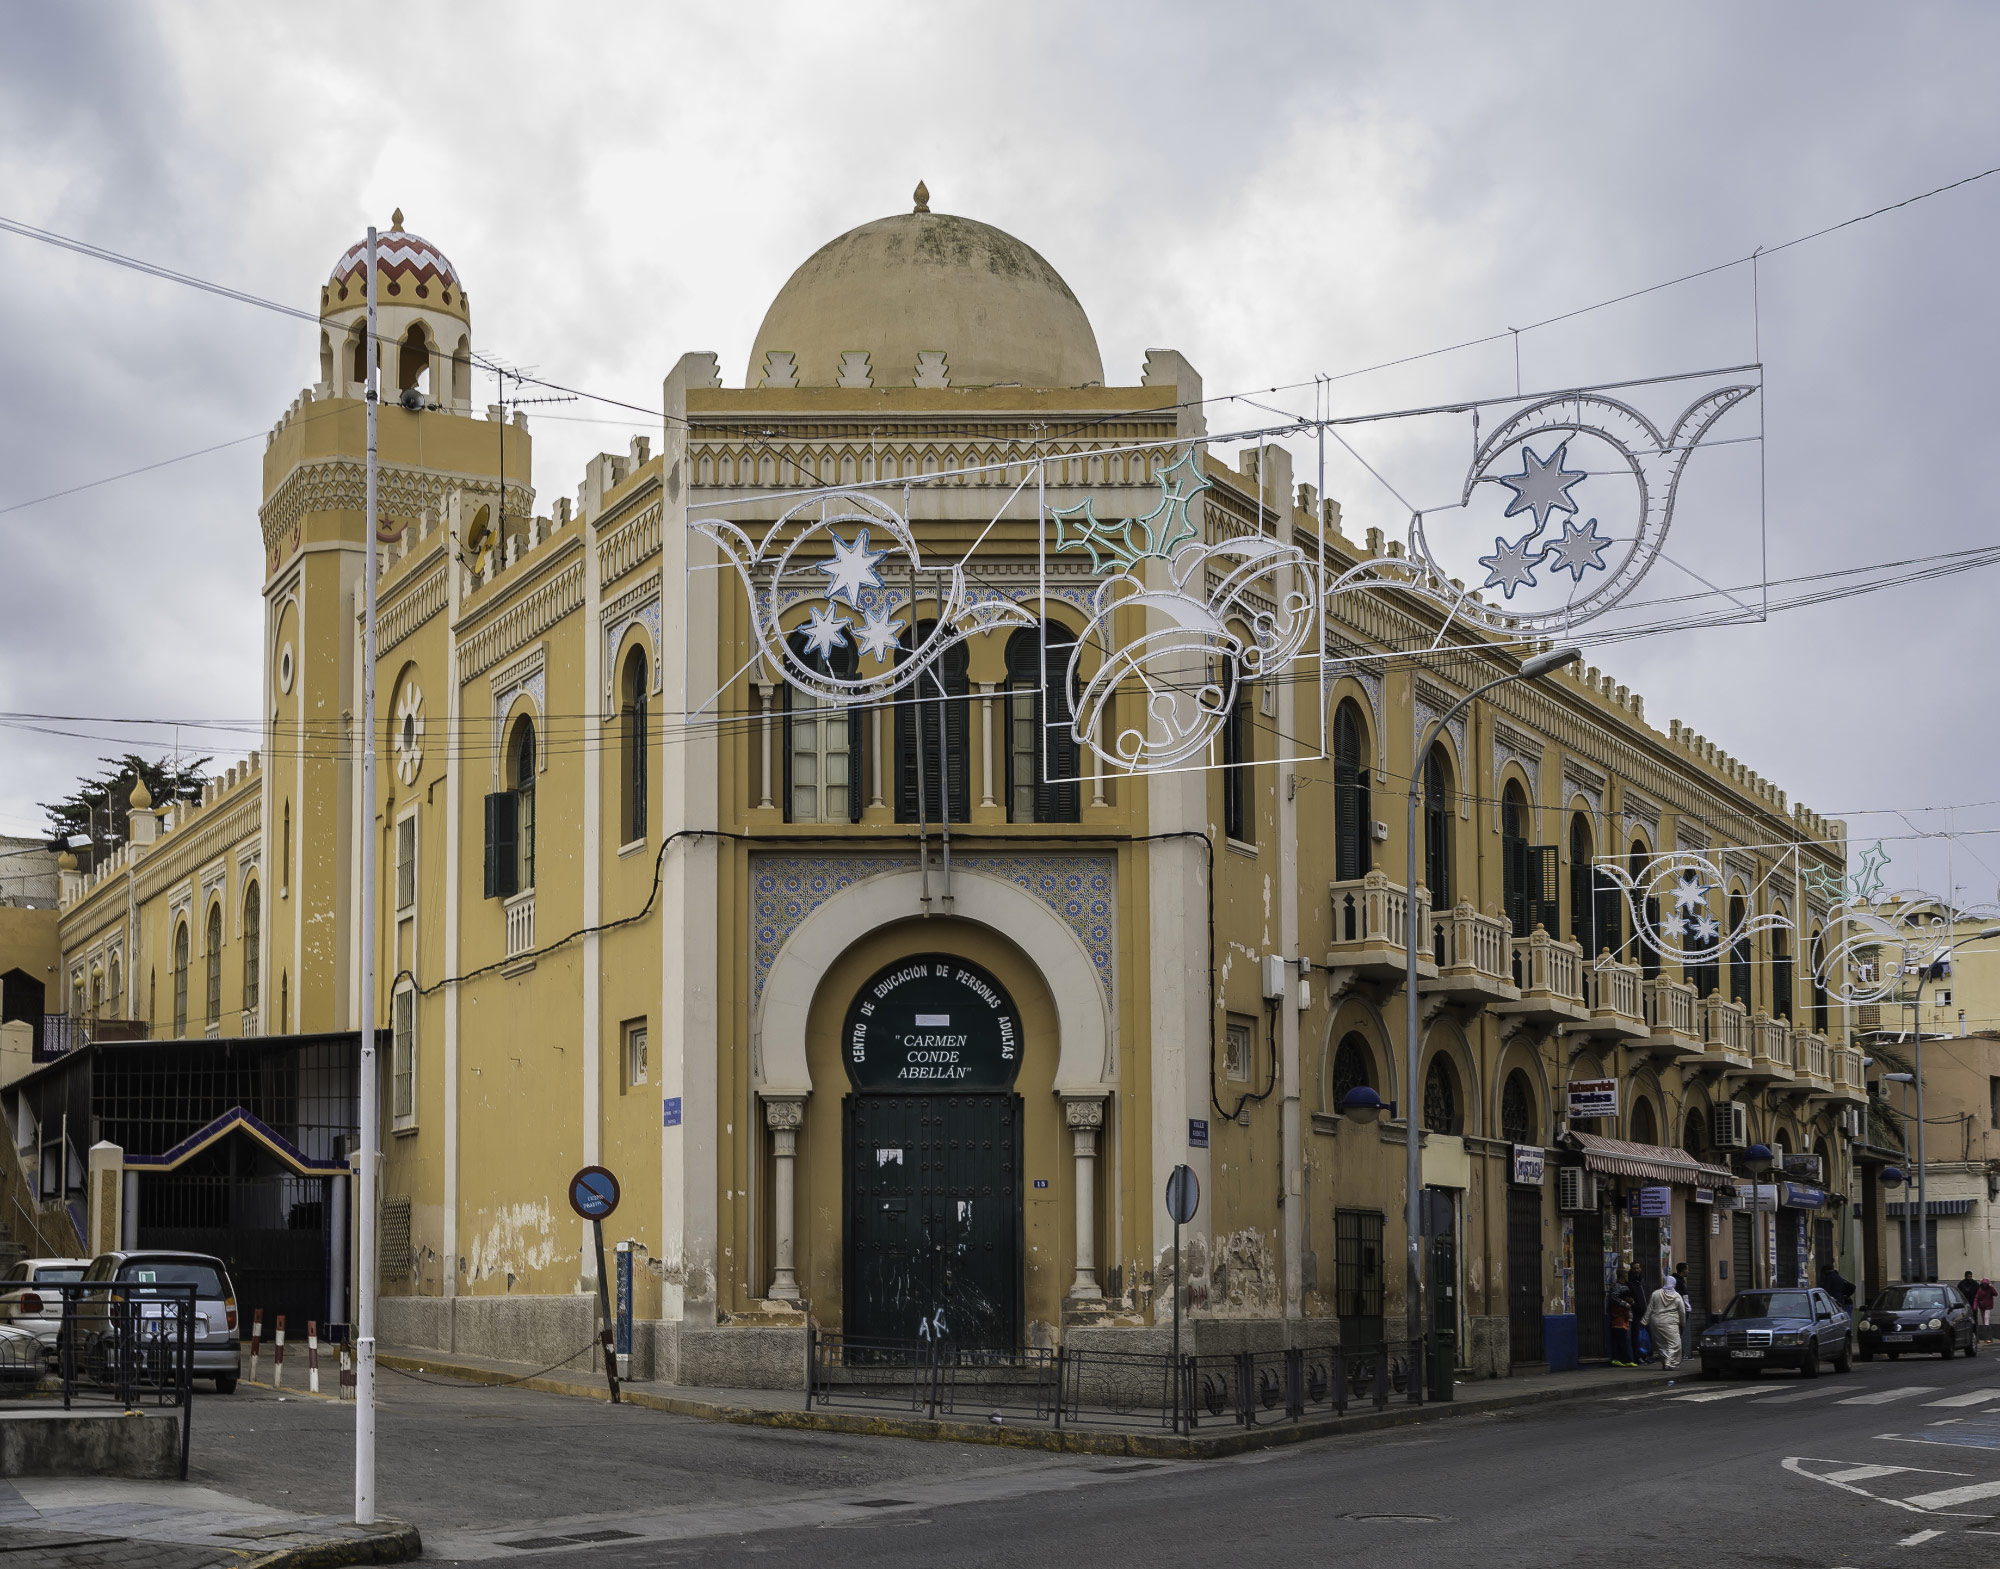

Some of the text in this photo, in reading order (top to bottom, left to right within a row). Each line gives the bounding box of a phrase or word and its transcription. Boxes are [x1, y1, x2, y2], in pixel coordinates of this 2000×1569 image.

[853, 1023, 867, 1063] CENTRO
[860, 1001, 875, 1016] DE
[936, 964, 949, 977] DE
[955, 969, 1002, 1009] PERSONAS
[997, 1016, 1015, 1060] ADULTAS
[907, 1051, 960, 1063] CONDE
